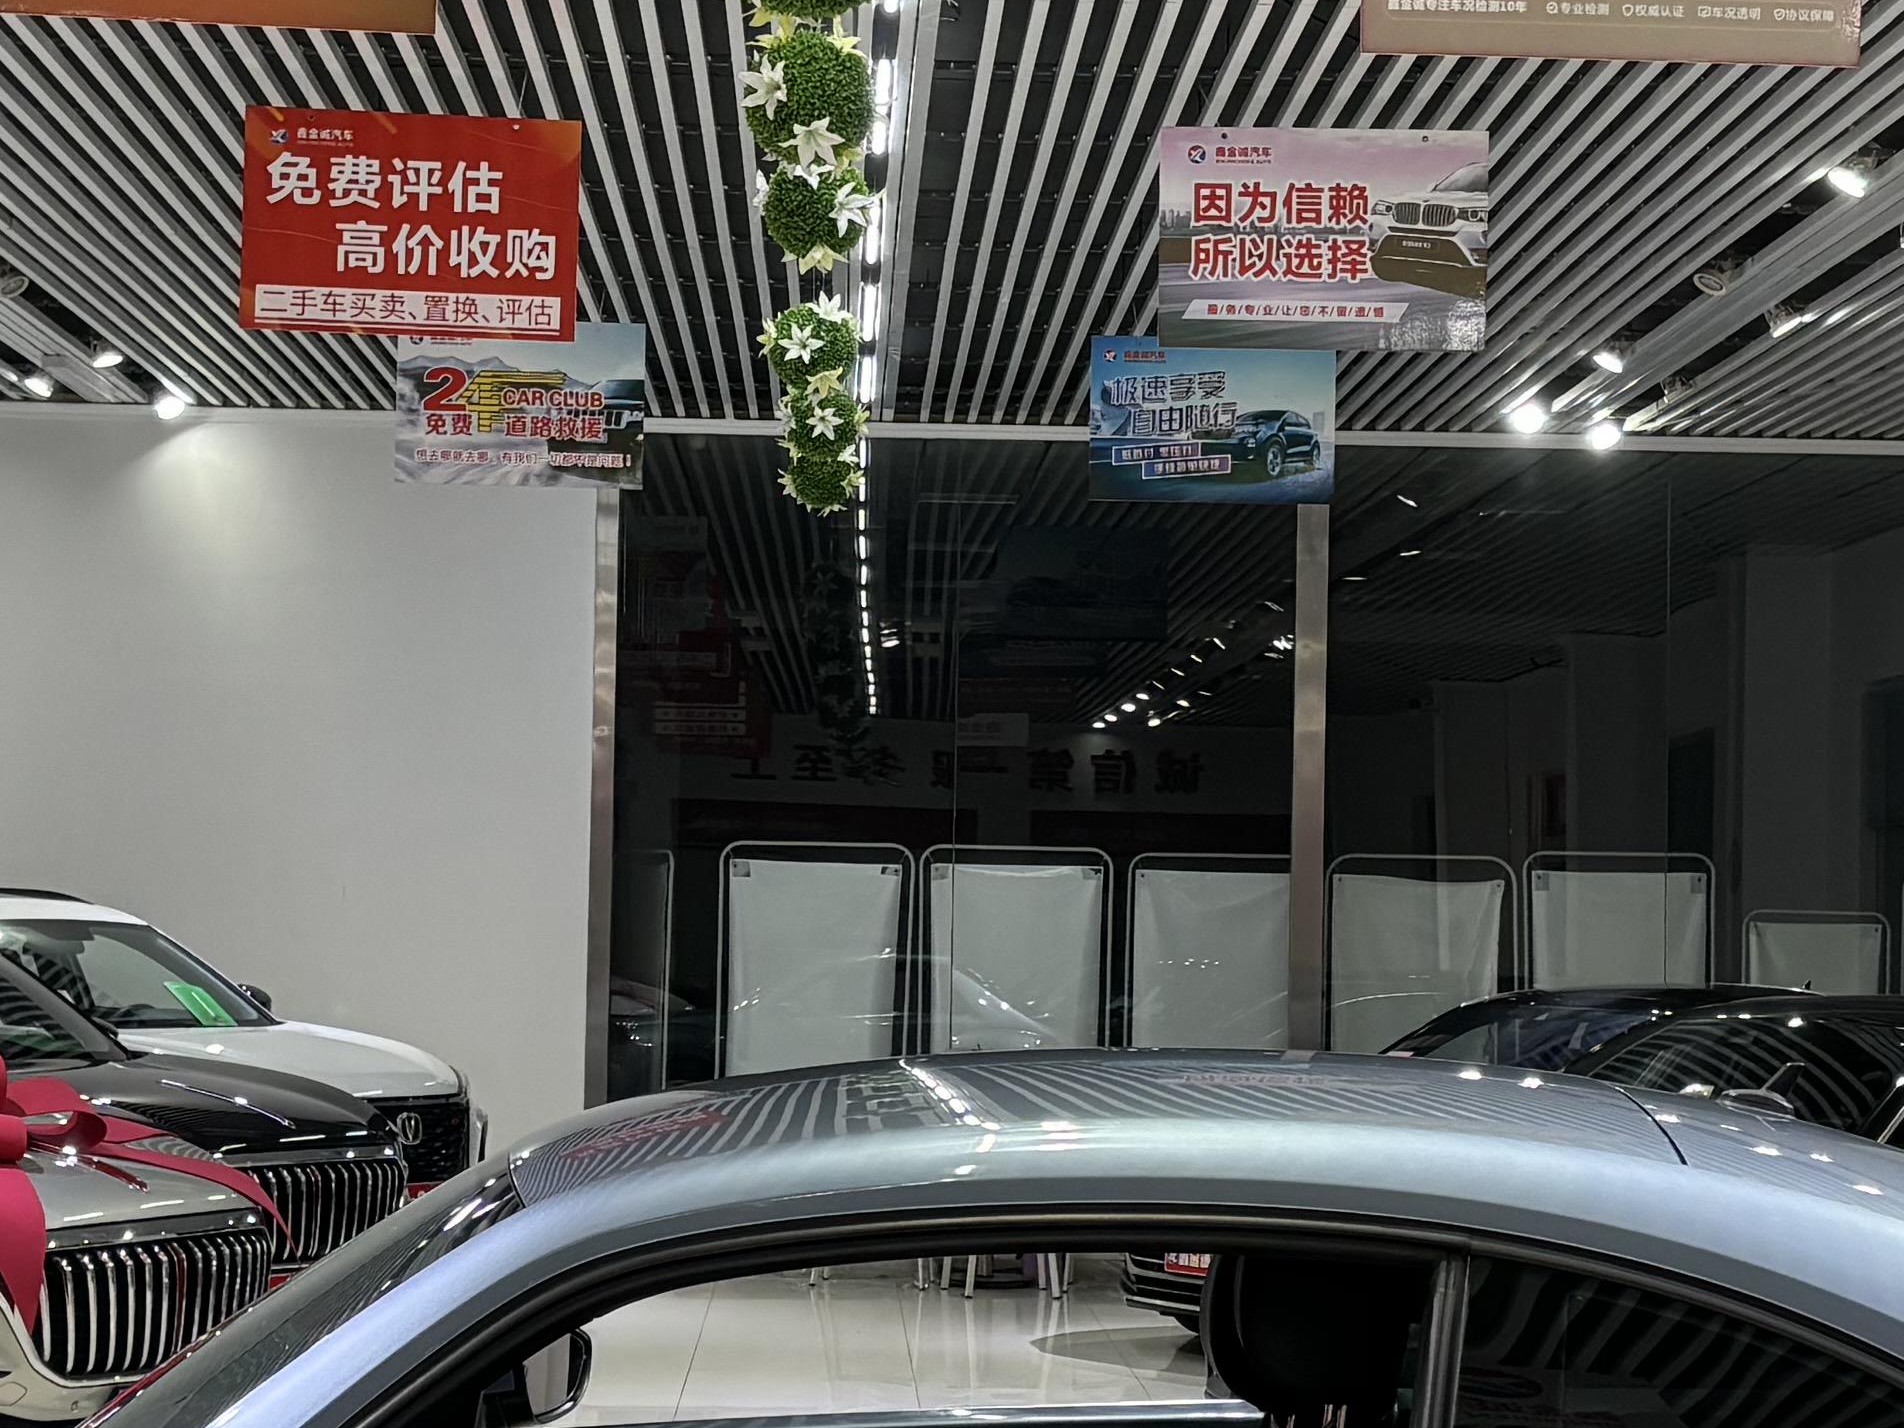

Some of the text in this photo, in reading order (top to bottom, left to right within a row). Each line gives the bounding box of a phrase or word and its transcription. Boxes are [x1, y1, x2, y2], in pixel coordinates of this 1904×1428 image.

[1635, 4, 1684, 18] 权威认证
[1785, 8, 1835, 22] 协议保障
[265, 151, 504, 214] 免费评估
[1193, 182, 1369, 227] 因为信赖
[335, 220, 556, 280] 高价收购
[1192, 235, 1370, 282] 所以选择
[259, 289, 554, 327] 二手车买卖、置换、评估
[502, 388, 605, 409] CAR CLUB
[1110, 370, 1226, 406] 极速享受
[425, 413, 606, 441] 免费 道路救援
[1131, 402, 1237, 437] 自由随行
